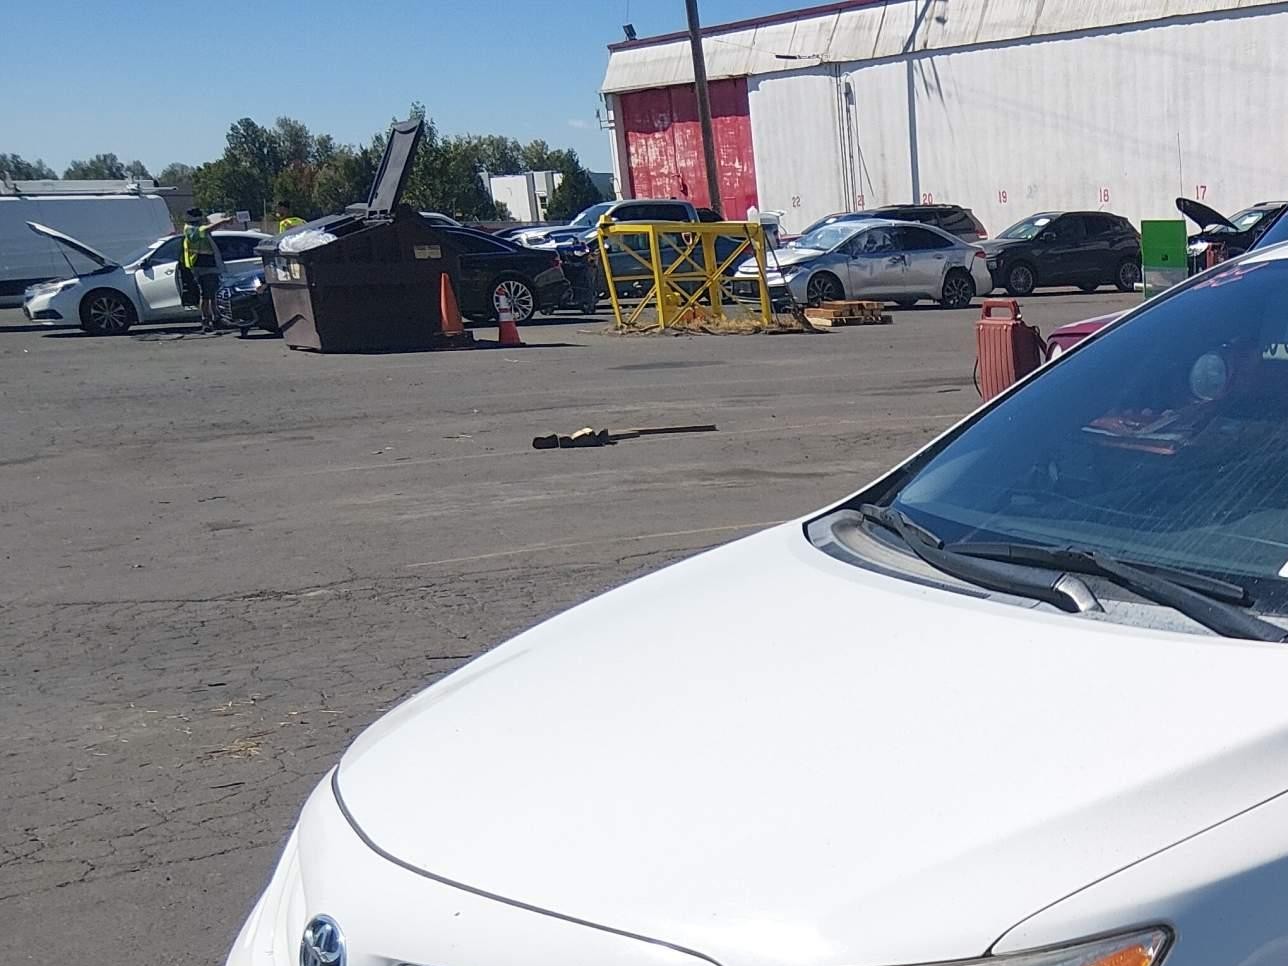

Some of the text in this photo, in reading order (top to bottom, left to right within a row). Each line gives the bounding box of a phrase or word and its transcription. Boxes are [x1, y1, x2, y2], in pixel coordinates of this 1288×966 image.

[923, 193, 933, 205] 20
[998, 190, 1008, 204] 19
[1099, 188, 1109, 202] 18
[1195, 186, 1207, 199] 17
[792, 196, 801, 208] 22
